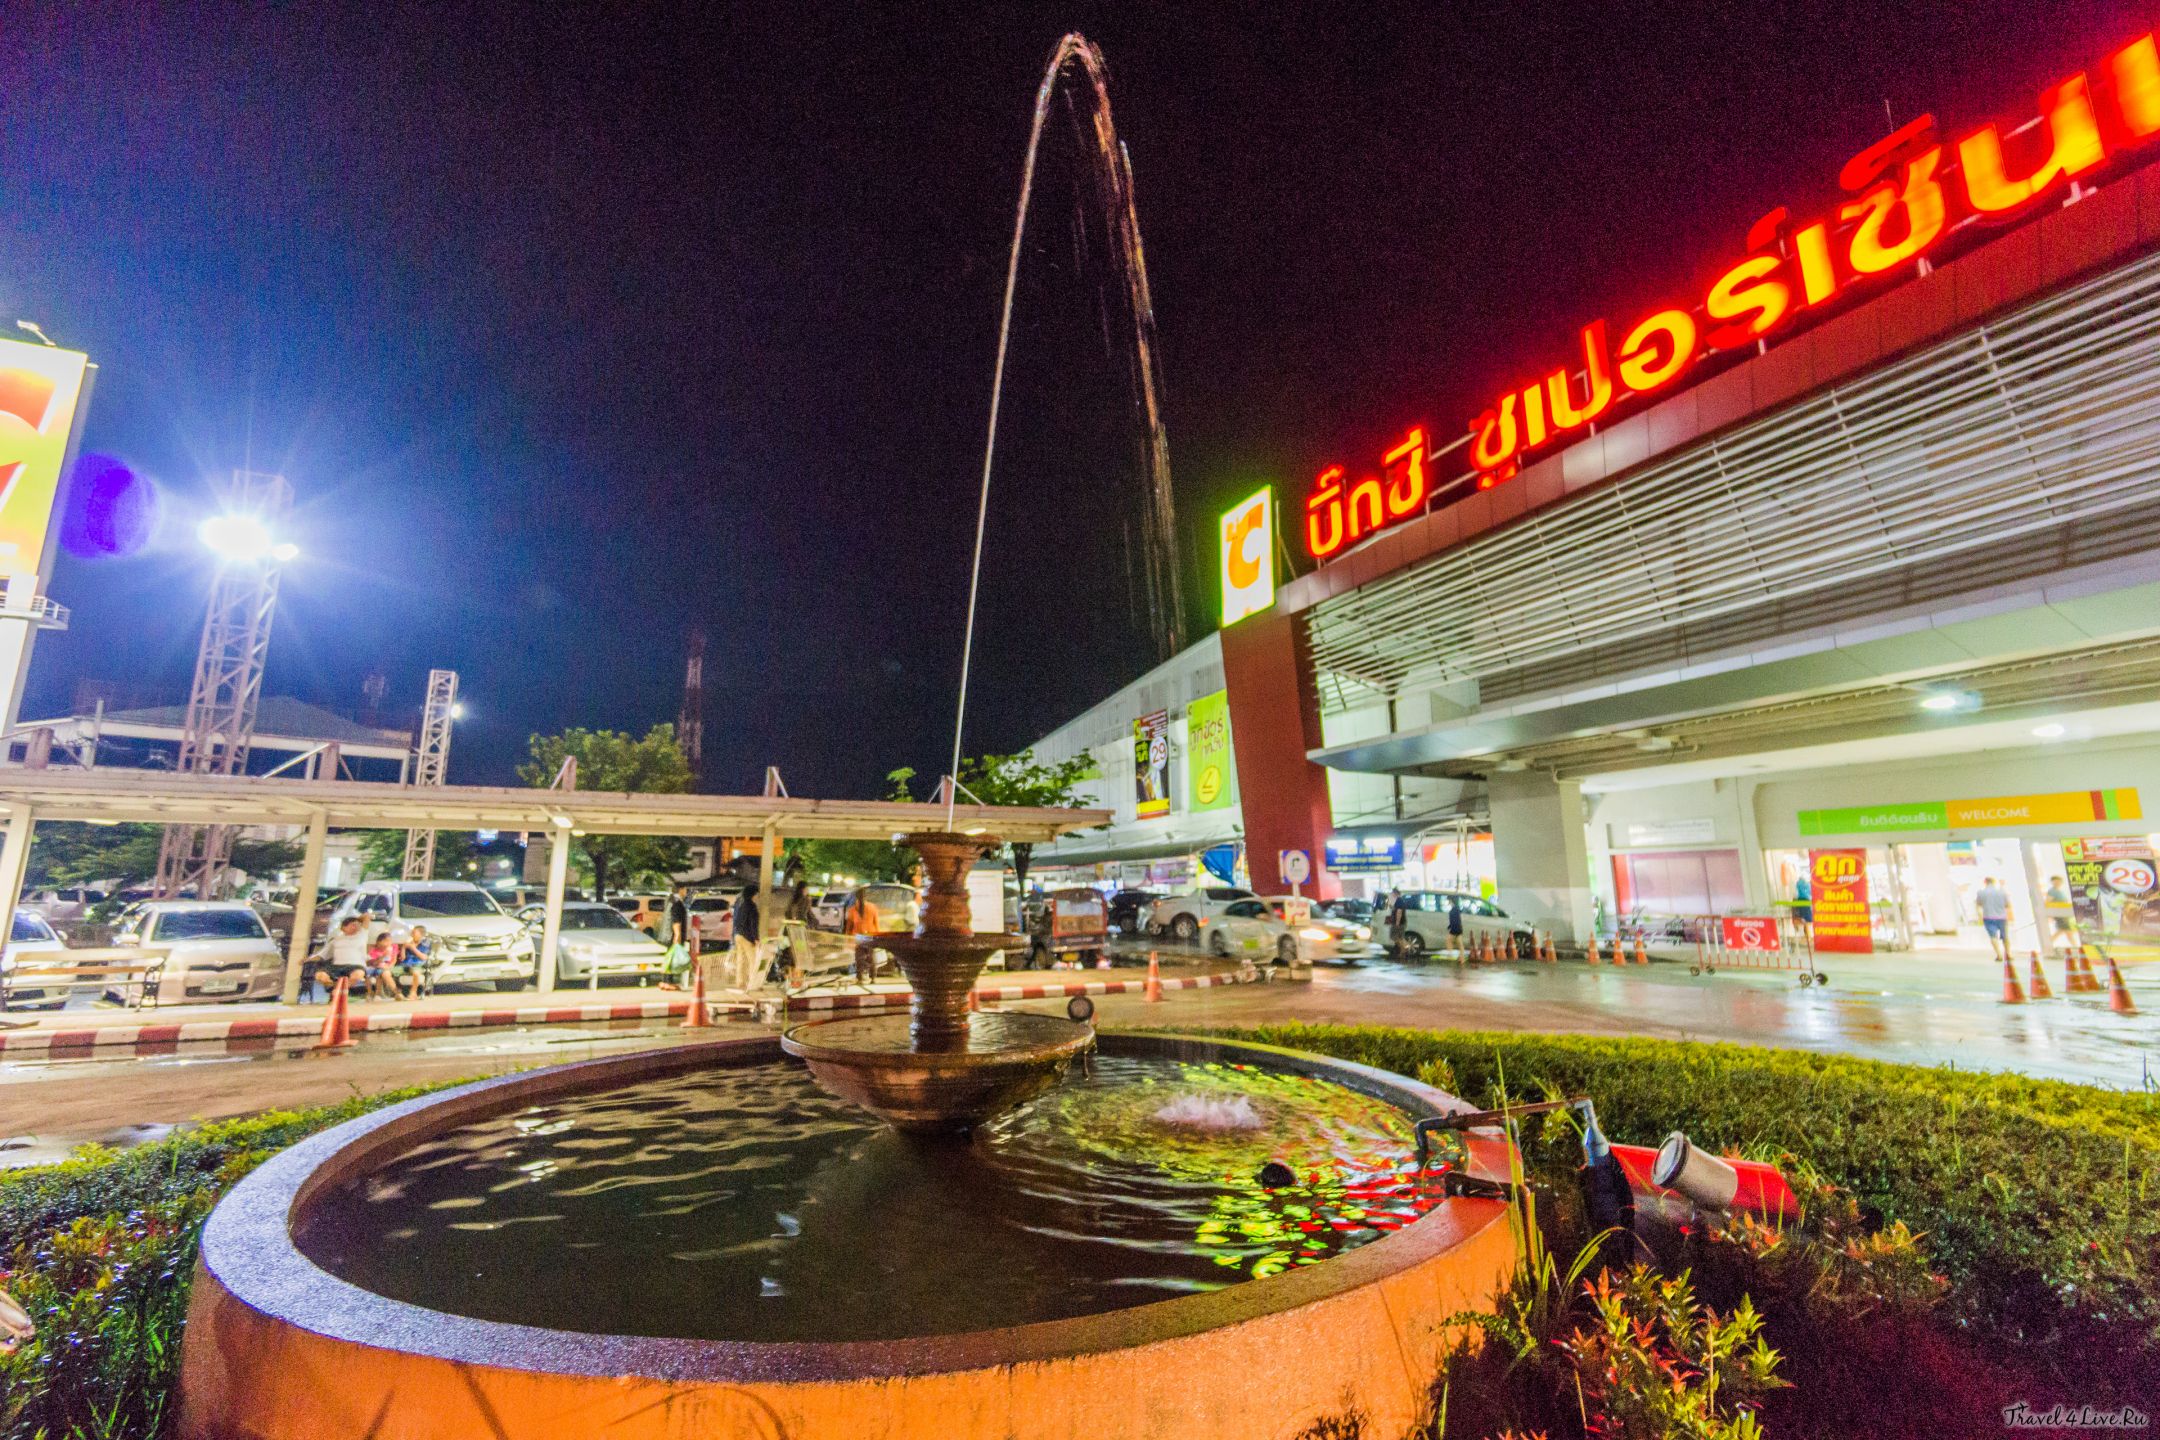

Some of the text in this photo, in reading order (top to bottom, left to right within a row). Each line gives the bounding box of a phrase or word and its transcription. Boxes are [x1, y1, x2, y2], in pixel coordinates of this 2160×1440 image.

[1151, 742, 1167, 765] 29
[1958, 807, 2031, 821] WELCOME
[1815, 854, 1856, 883] ถูก
[2111, 867, 2151, 887] 29
